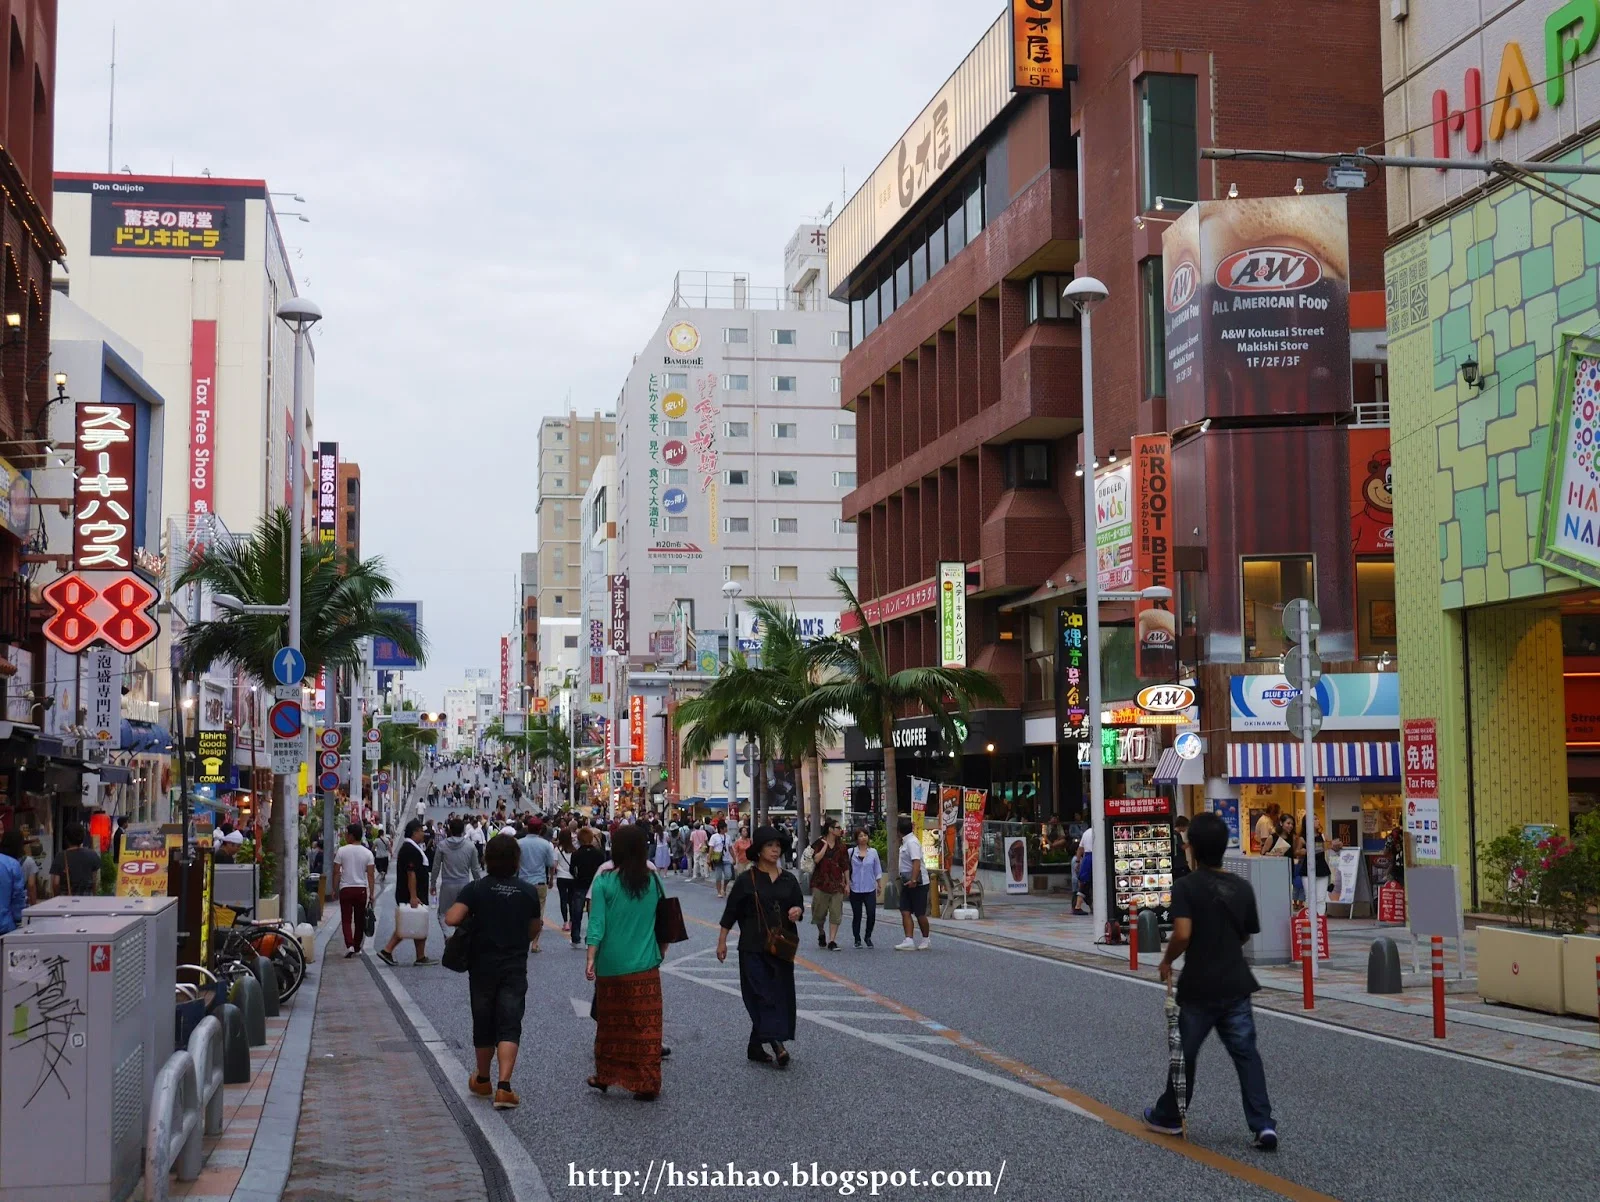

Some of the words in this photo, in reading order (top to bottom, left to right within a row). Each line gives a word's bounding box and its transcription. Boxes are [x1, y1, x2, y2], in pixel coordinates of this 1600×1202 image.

[1029, 74, 1051, 86] 5F
[92, 182, 110, 192] Don
[112, 182, 144, 194] Quijote
[125, 209, 212, 229] 驚安の殿堂
[1232, 256, 1307, 285] A&W
[1212, 300, 1229, 315] ALL
[1233, 295, 1294, 312] AMERICAN
[1299, 294, 1328, 310] FOOD
[1221, 328, 1245, 339] A&W
[1248, 327, 1289, 338] Kokusai
[1291, 326, 1324, 337] Street
[1237, 341, 1278, 352] Makishi
[1280, 341, 1308, 351] Store
[196, 378, 211, 405] Tax
[195, 410, 210, 445] Free
[1140, 444, 1166, 455] A&W
[192, 449, 209, 490] Shop
[78, 406, 131, 567] ステーキハウス
[320, 454, 334, 523] 驚安の殿堂
[1150, 456, 1168, 531] ROOT
[613, 588, 625, 650] ホテル山の内
[96, 654, 112, 728] 泡盛専門店
[199, 740, 227, 748] Goods
[200, 731, 227, 740] Tshirts
[325, 734, 336, 744] 30
[901, 727, 927, 747] COFFEE
[199, 747, 227, 756] Design
[1406, 744, 1435, 770] 免税
[199, 775, 226, 783] COSMIC
[1407, 777, 1420, 789] Tax
[1420, 777, 1436, 789] Free
[122, 862, 157, 873] 3F
